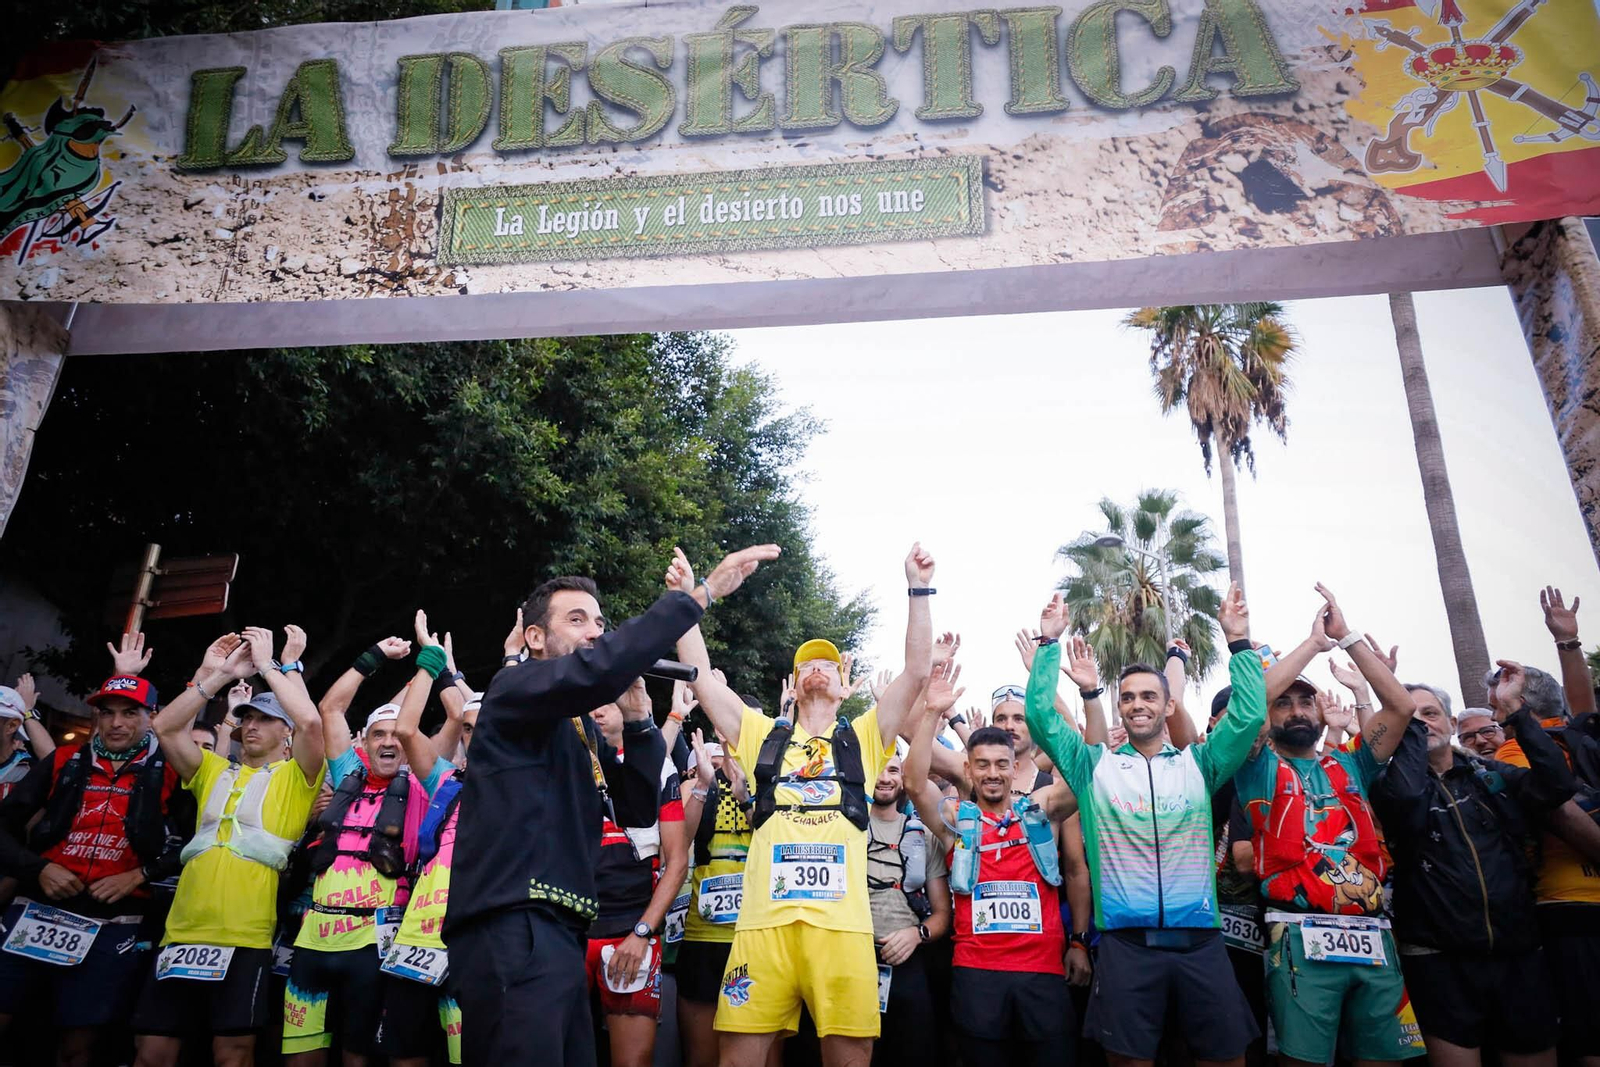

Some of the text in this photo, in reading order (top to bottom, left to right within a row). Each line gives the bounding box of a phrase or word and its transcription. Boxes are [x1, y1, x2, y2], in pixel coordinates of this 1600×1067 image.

[177, 0, 1301, 169] LA DESÉRTICA
[494, 188, 925, 239] La Legión y el desierto nos une
[793, 811, 839, 826] CHAKALES
[794, 865, 830, 886] 390
[988, 902, 1031, 920] 1008
[30, 925, 82, 952] 3338
[1221, 917, 1261, 942] 3630
[1322, 931, 1373, 955] 3405
[171, 947, 222, 967] 2082
[403, 945, 437, 970] 222
